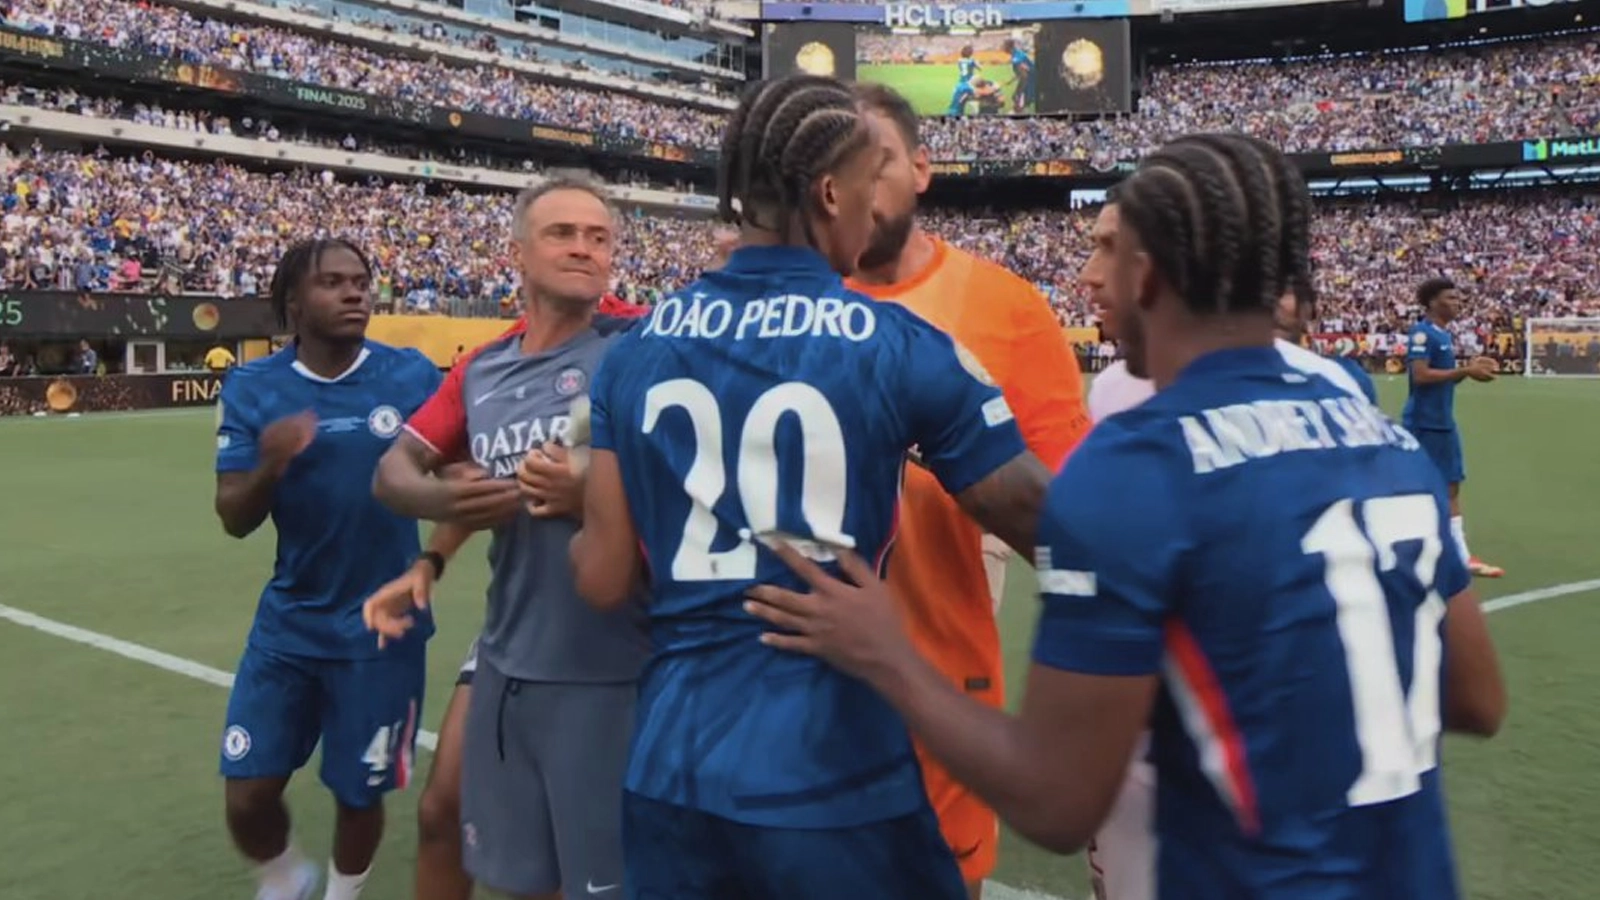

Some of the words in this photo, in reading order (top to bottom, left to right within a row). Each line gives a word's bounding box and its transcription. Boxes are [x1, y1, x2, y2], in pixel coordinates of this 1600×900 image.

[884, 3, 1003, 28] HCLTech
[297, 86, 336, 105] FINAL
[337, 94, 367, 110] 2025
[1551, 139, 1600, 157] MetL
[734, 294, 876, 342] PEDRO
[172, 379, 222, 401] FINA
[471, 415, 573, 468] QATAR
[641, 377, 857, 582] 20
[1300, 493, 1447, 808] 17
